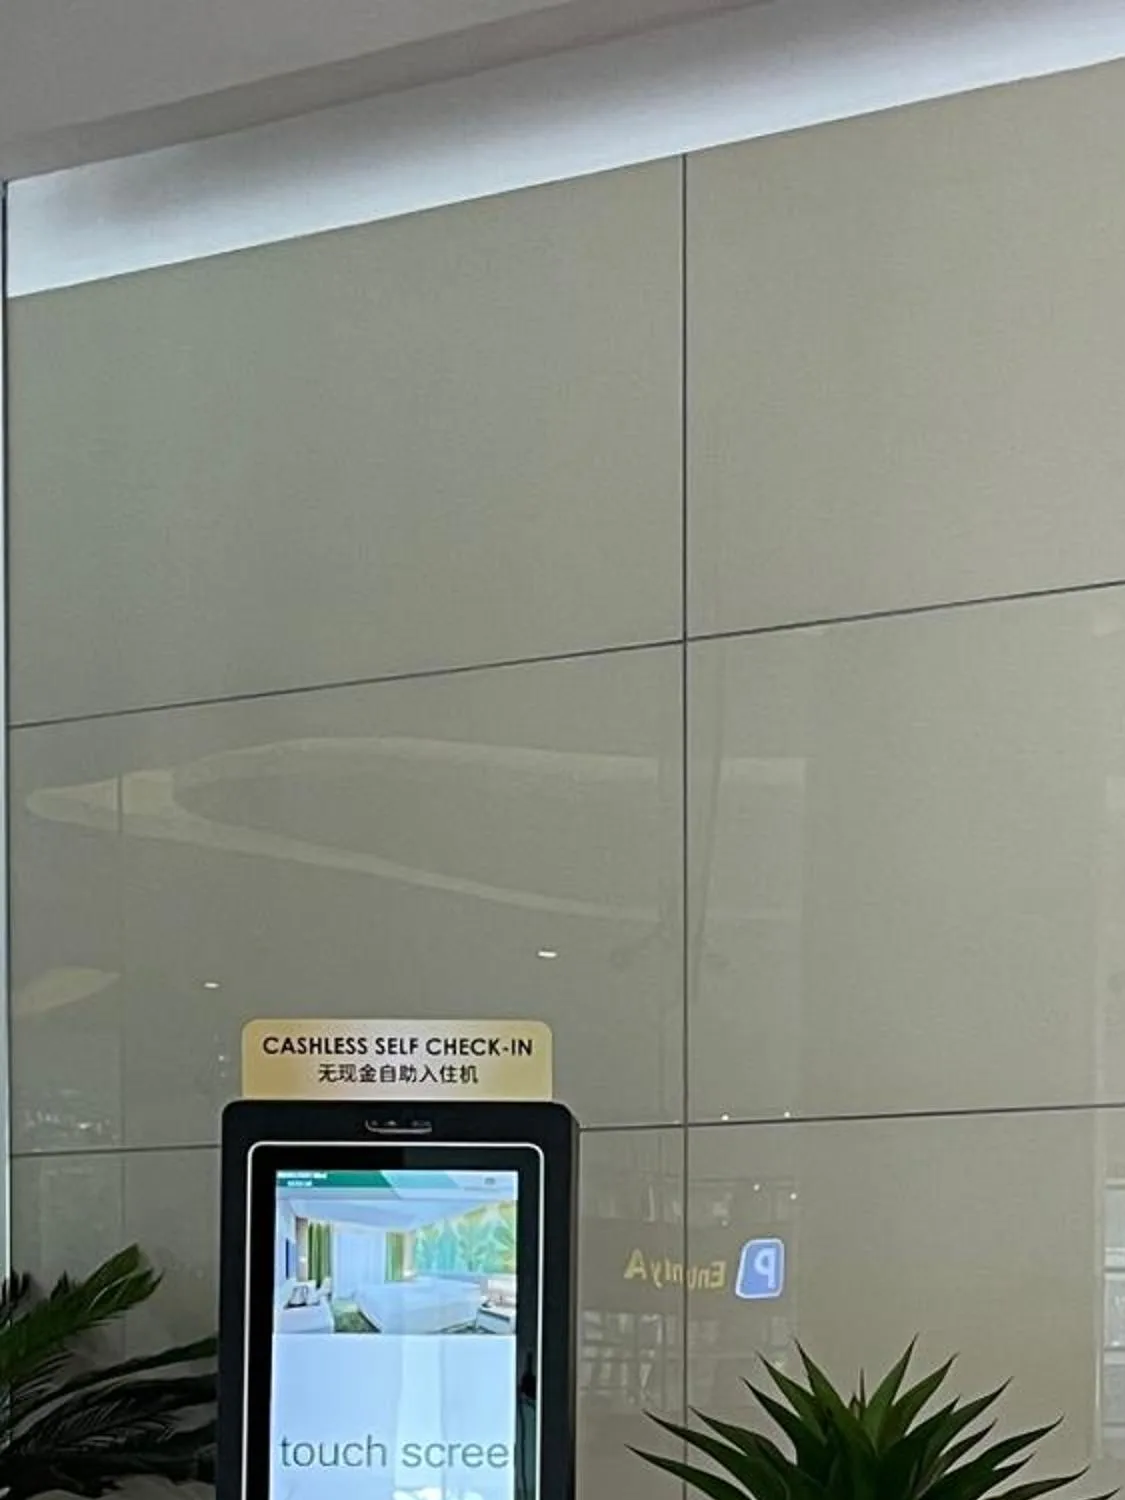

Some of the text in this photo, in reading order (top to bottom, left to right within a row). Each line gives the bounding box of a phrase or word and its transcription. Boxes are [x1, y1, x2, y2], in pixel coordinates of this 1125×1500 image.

[263, 1036, 534, 1056] CASHLESS SELF CHECK-IN
[317, 1062, 480, 1084] 无现金自助入住机
[278, 1434, 510, 1469] touch scree
